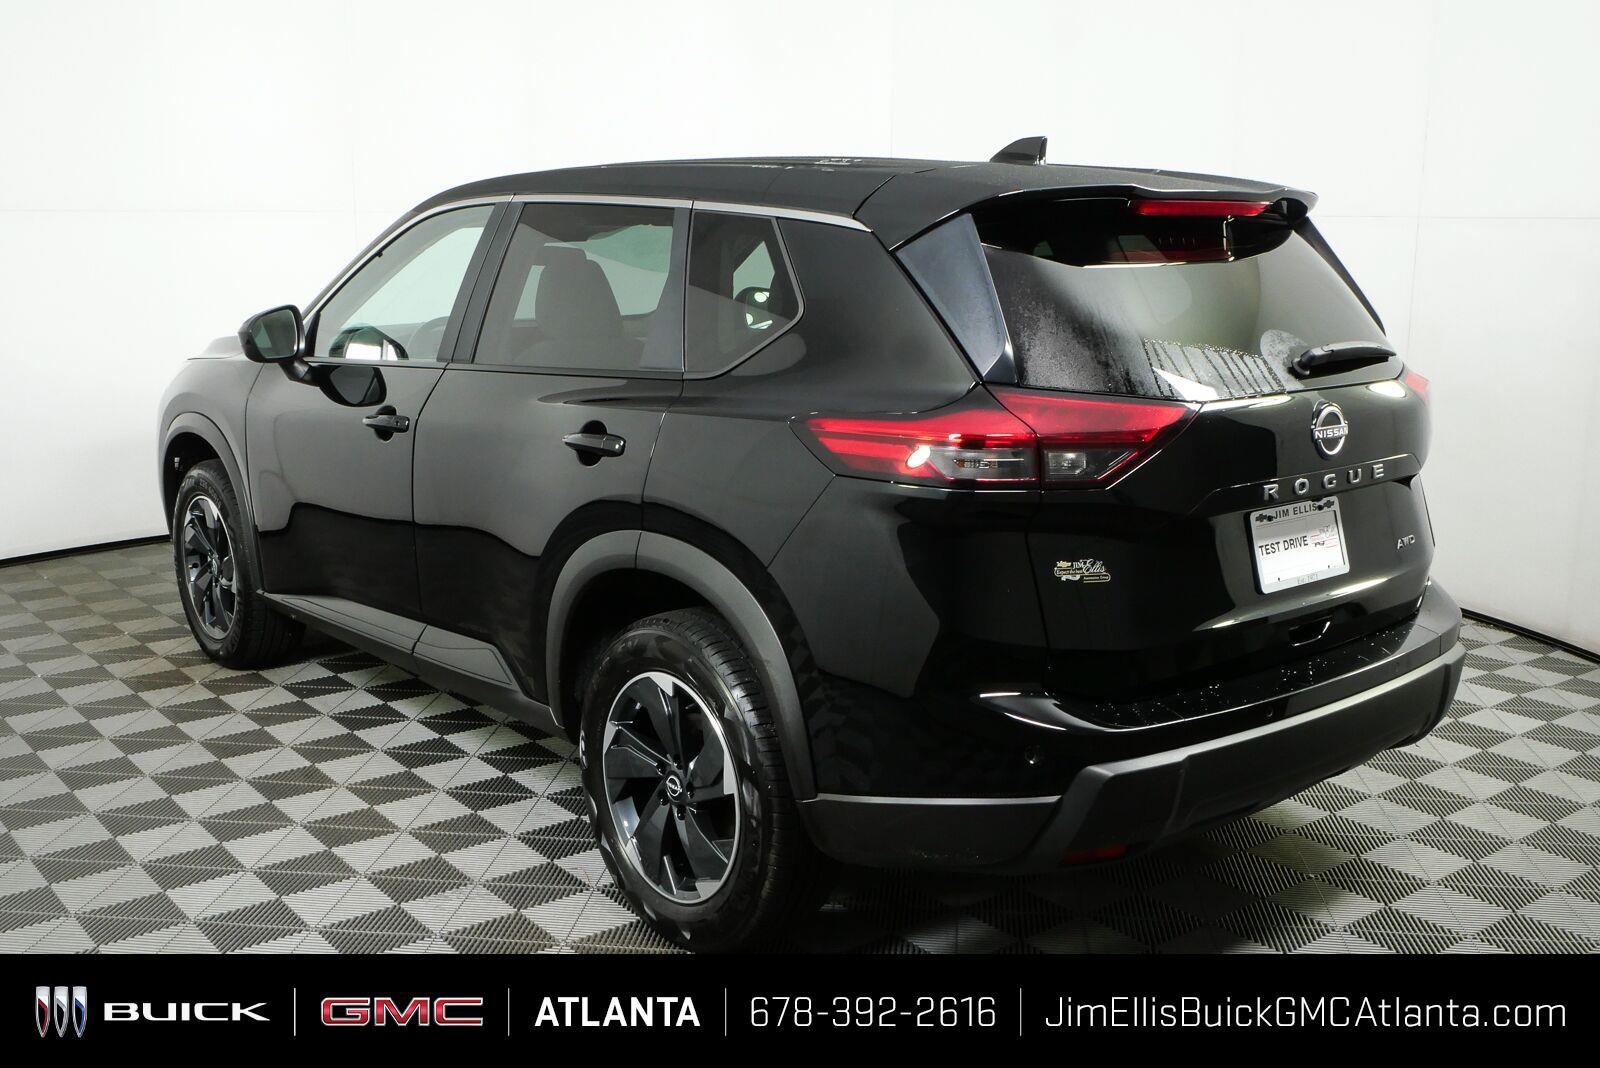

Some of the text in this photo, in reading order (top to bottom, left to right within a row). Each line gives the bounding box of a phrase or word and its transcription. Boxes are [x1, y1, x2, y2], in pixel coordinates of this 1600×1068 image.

[1314, 427, 1348, 440] NISSAN
[1263, 463, 1385, 501] ROGUE
[1273, 502, 1318, 520] JIM ELLIS
[1258, 541, 1281, 557] TEST
[1282, 535, 1309, 551] DRIVE
[1397, 534, 1416, 550] AWD
[1072, 558, 1106, 574] JIM Ellis
